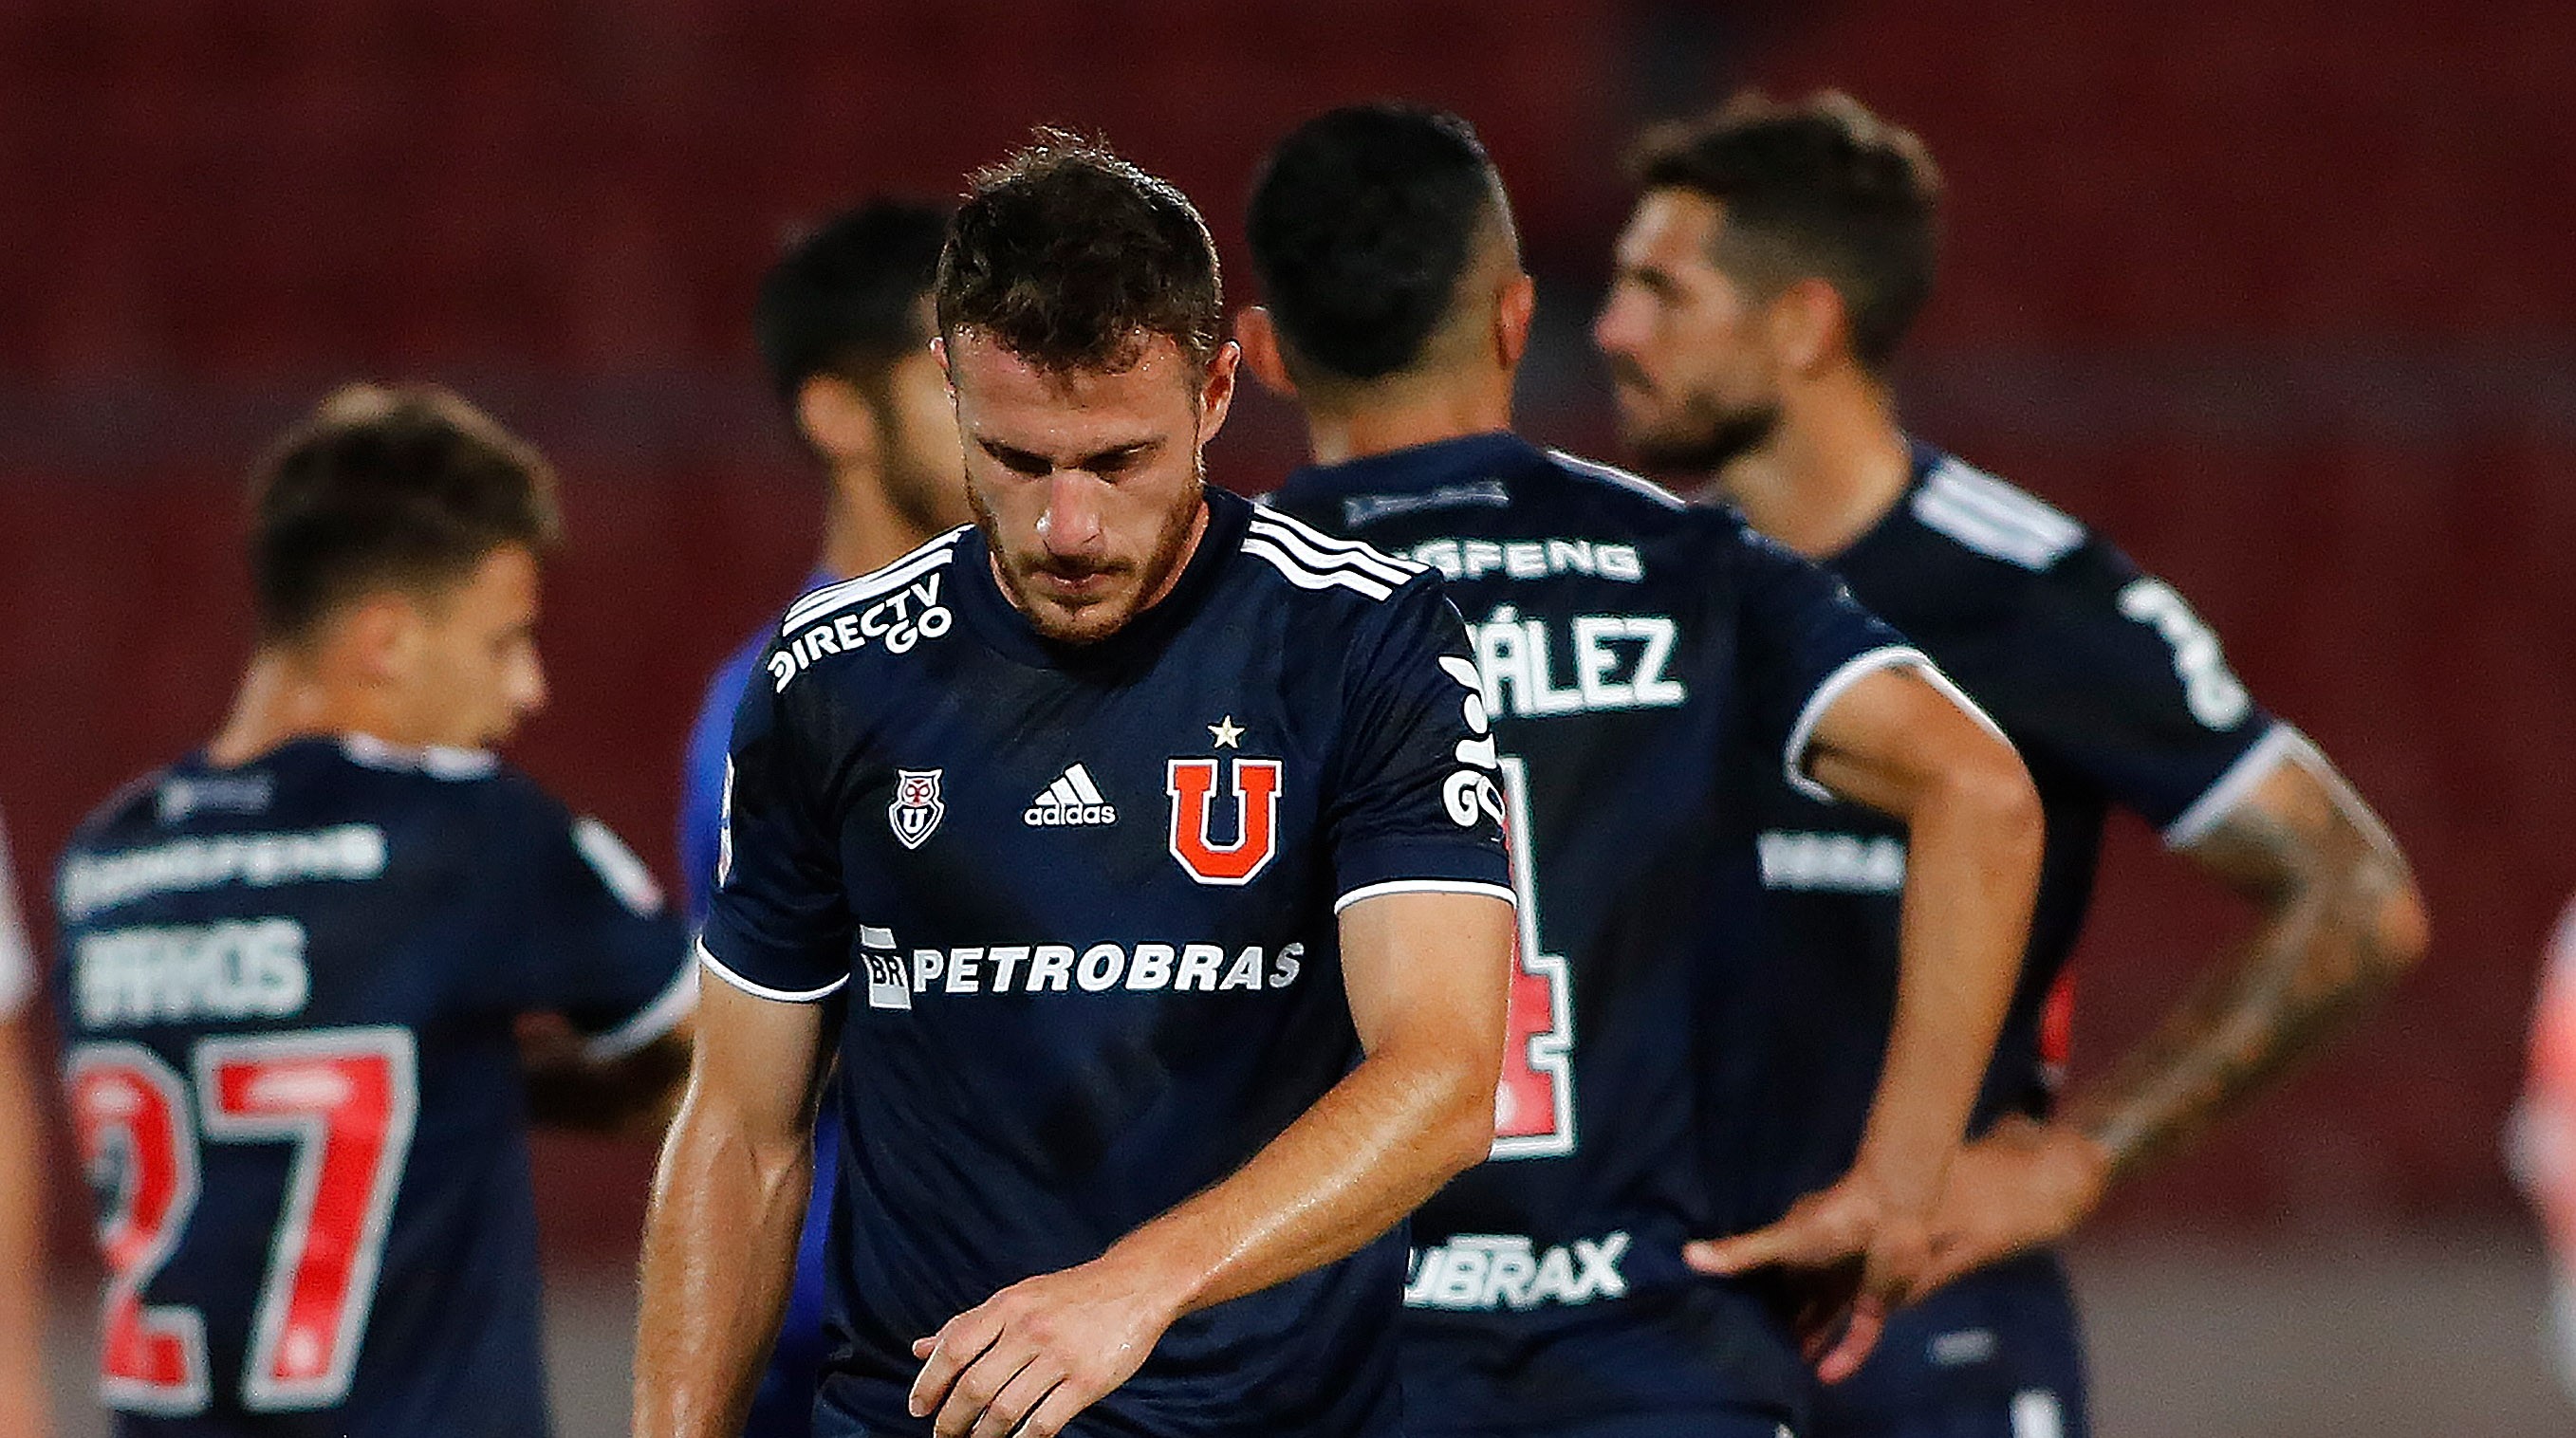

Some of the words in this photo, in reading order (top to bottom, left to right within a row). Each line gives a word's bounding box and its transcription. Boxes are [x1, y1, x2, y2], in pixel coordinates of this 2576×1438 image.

[1395, 538, 1644, 583] GFENG
[767, 572, 940, 693] DIRECTV
[884, 606, 953, 654] GO
[1464, 602, 1687, 719] ÁLEZ
[902, 808, 928, 834] U
[1024, 805, 1117, 826] adidas
[1167, 758, 1283, 885] U
[913, 941, 1305, 993] PETROBRAS
[66, 1024, 419, 1414] 27
